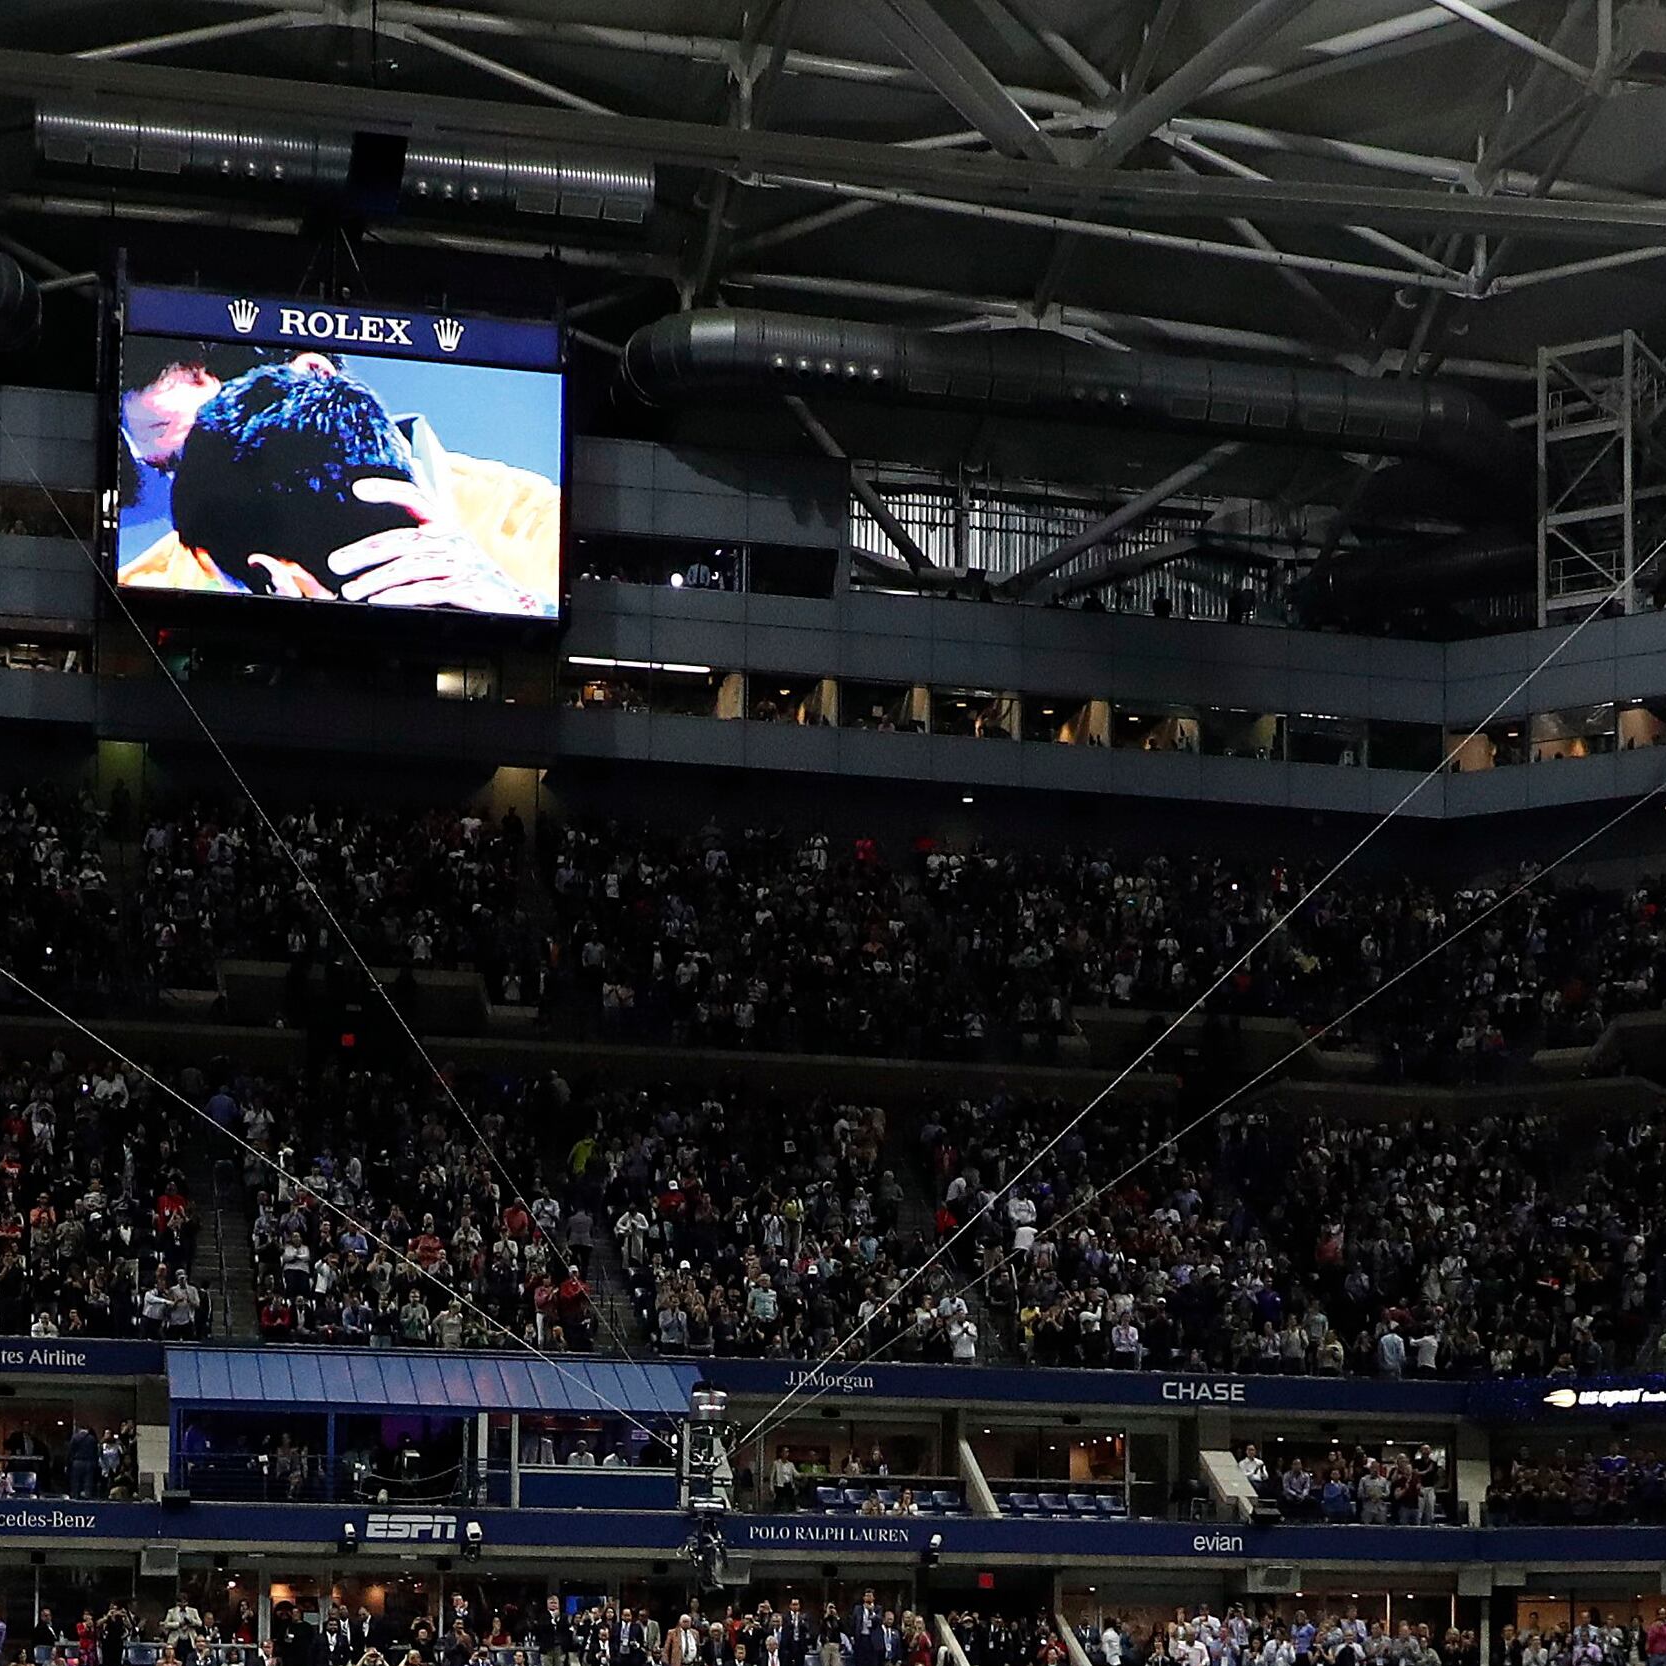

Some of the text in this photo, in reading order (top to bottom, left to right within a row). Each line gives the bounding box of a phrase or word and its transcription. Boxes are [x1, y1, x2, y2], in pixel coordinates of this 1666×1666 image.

[279, 308, 413, 345] ROLEX
[28, 1348, 87, 1367] Airline
[1162, 1381, 1245, 1402] CHASE
[365, 1514, 457, 1540] ESPN
[749, 1526, 909, 1543] POLO RALPH LAUREN
[1192, 1532, 1243, 1552] evian
